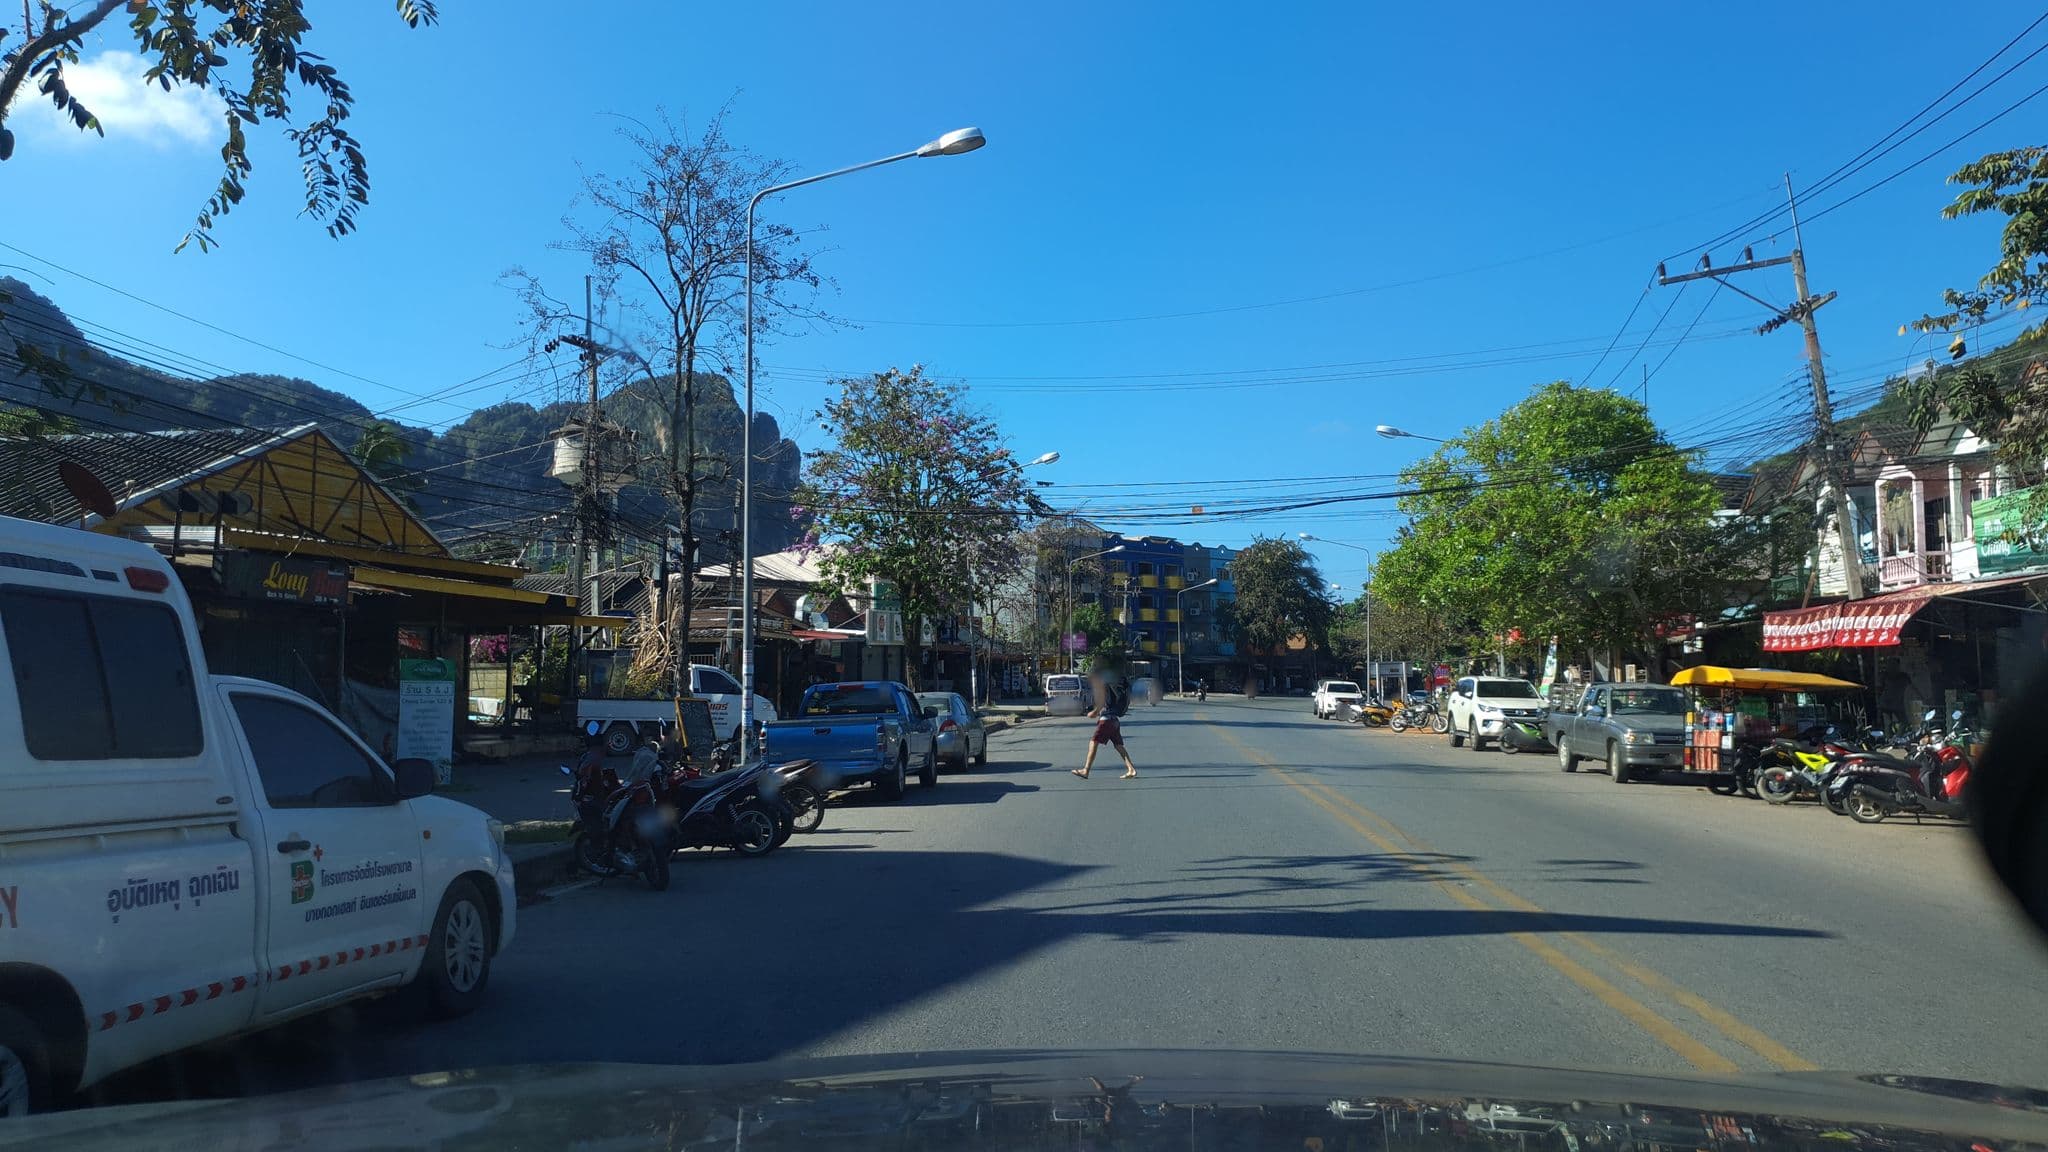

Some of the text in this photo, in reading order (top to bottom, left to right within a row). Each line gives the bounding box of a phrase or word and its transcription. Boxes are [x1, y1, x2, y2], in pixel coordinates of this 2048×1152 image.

[263, 560, 309, 598] Long
[107, 865, 240, 924] อุบัติเหตุ ฉุกเฉิน
